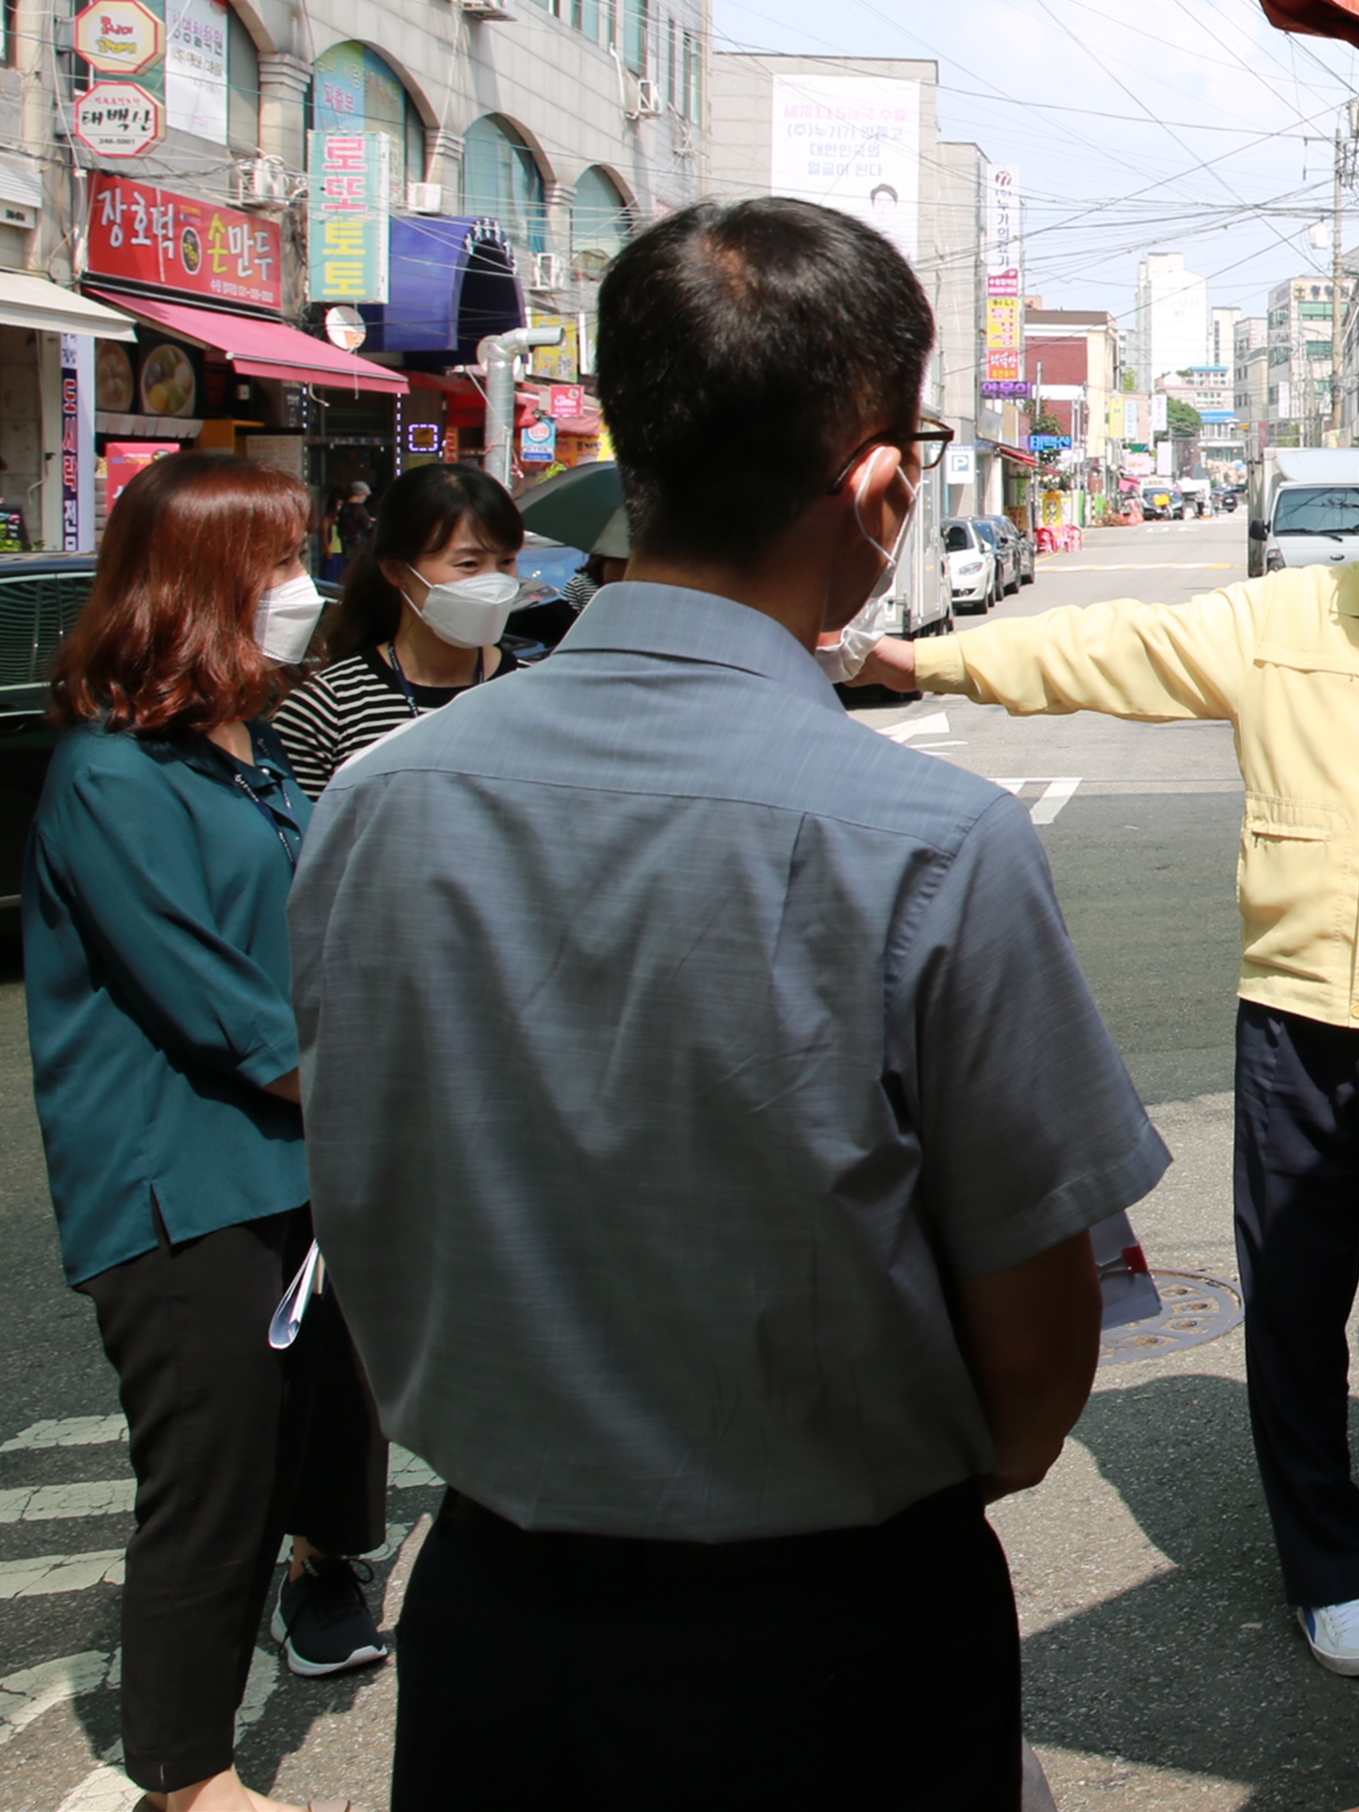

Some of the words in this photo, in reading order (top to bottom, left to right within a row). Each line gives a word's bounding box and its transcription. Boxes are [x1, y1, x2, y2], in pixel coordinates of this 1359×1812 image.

[82, 108, 152, 131] 태백산
[808, 161, 849, 176] 얼굴이
[810, 143, 880, 158] 대한민국의
[323, 137, 366, 212] 로또
[207, 213, 273, 281] 손만두
[323, 221, 366, 296] 토토
